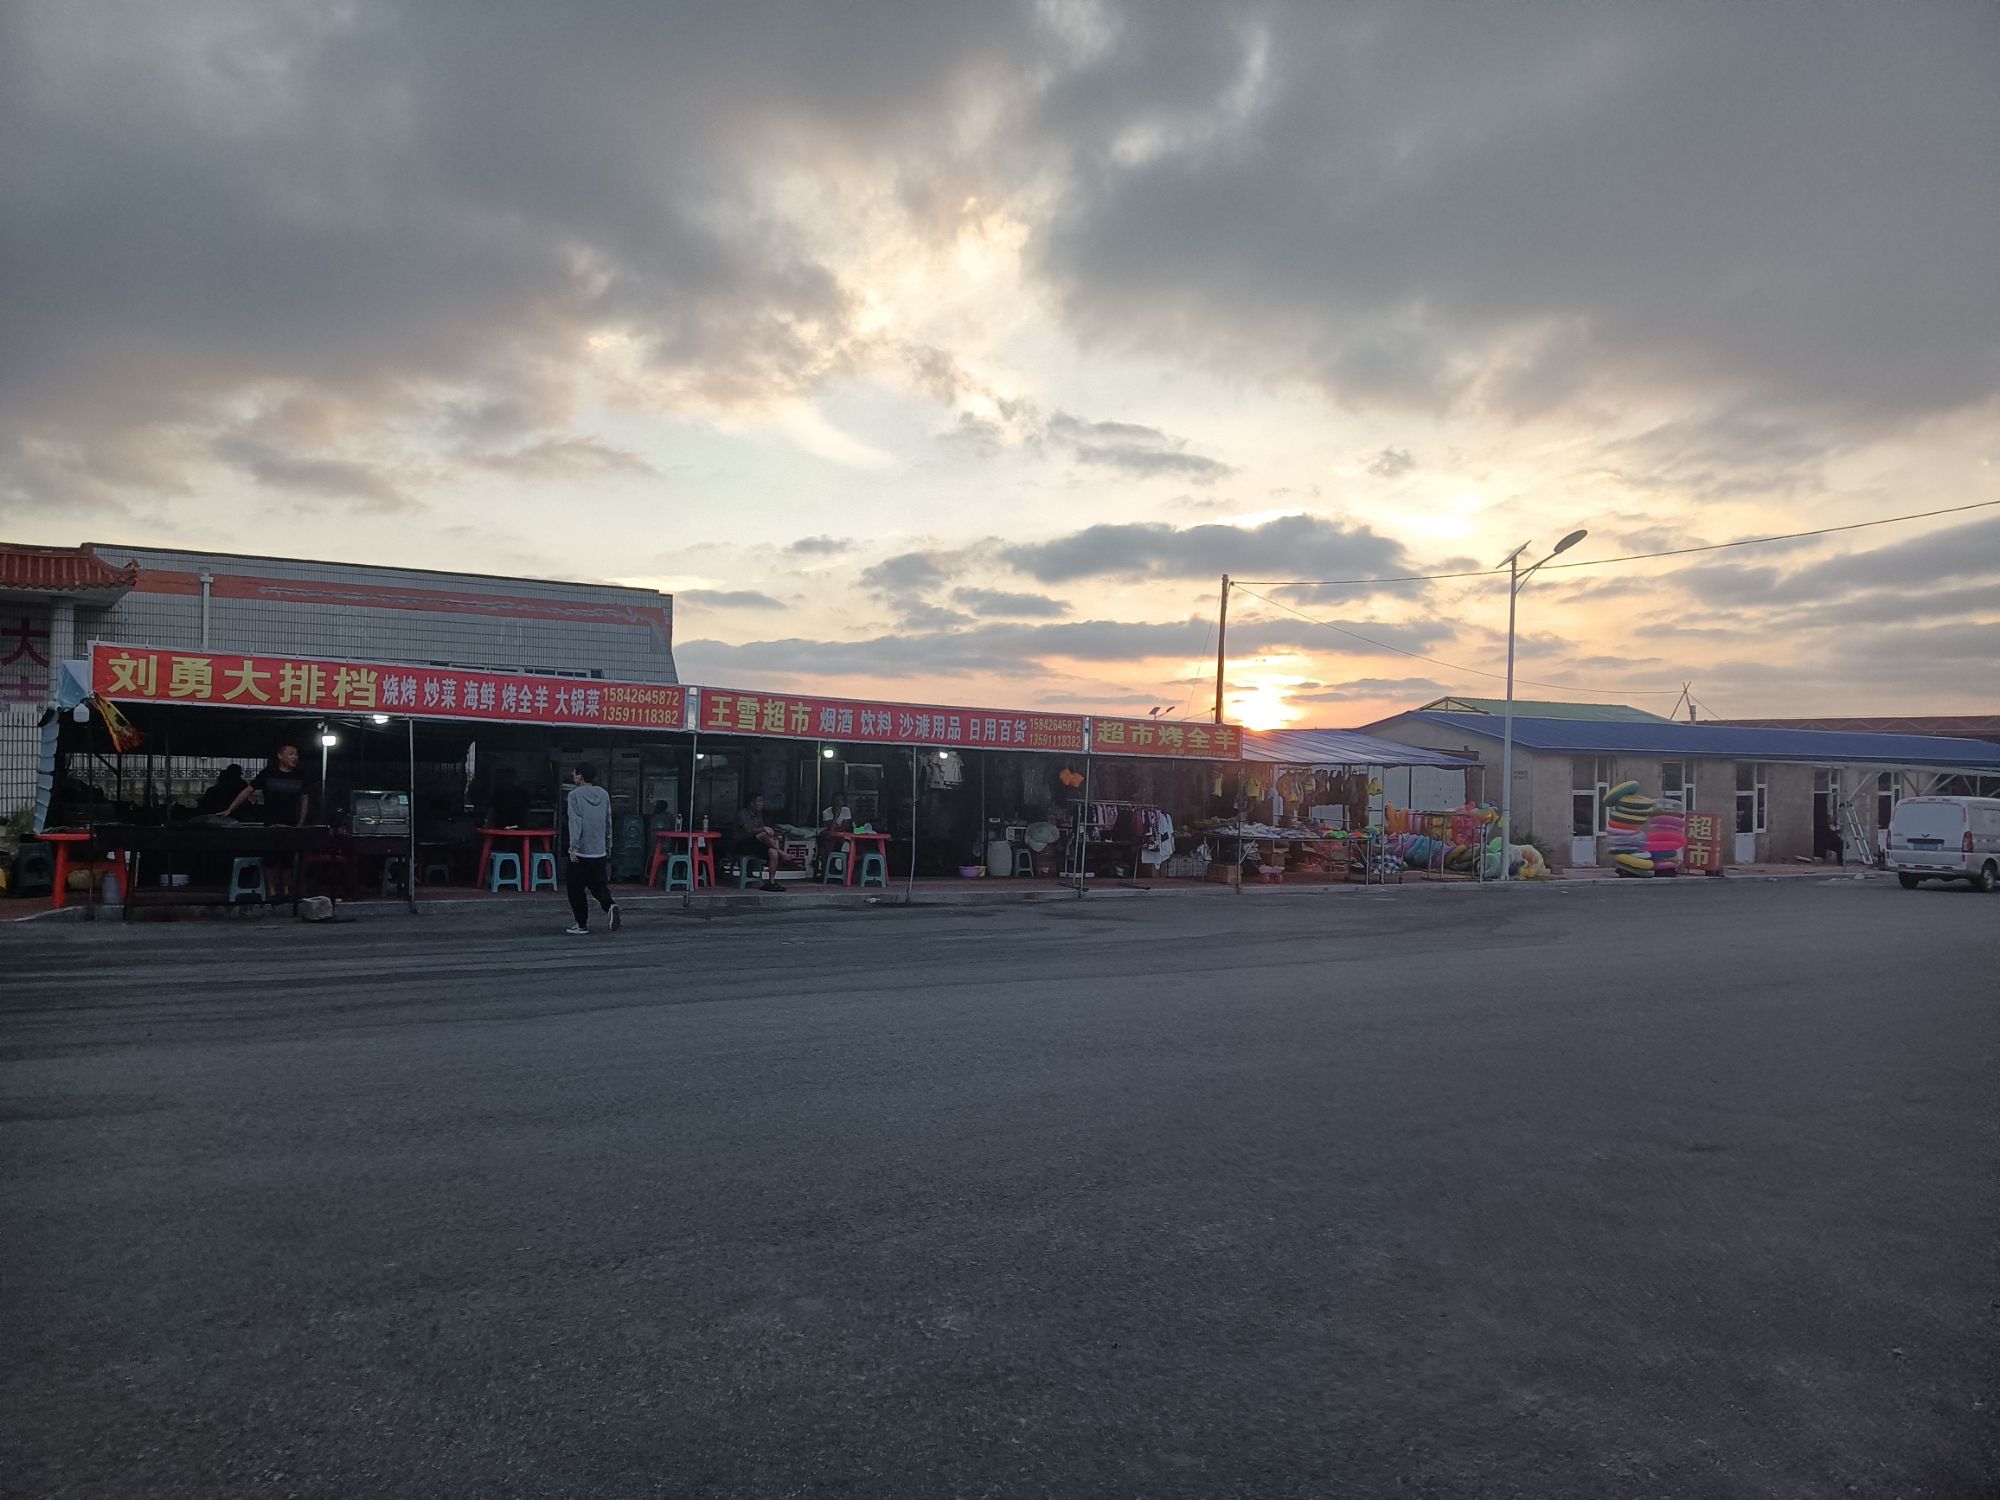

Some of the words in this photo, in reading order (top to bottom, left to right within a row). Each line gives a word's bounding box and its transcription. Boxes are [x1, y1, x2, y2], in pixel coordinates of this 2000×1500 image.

[107, 652, 379, 709] 刘勇大排档
[382, 674, 418, 707] 烧烤
[423, 676, 457, 709] 炒菜
[463, 680, 496, 711] 海鲜
[502, 682, 549, 716] 烤全羊
[554, 686, 600, 718] 大锅菜
[602, 687, 680, 706] 15842645872
[602, 706, 679, 725] 13591118382
[707, 695, 813, 734] 王雪超市
[819, 707, 853, 735] 烟酒
[860, 709, 892, 737] 饮料
[899, 713, 961, 741] 沙滩用品
[970, 718, 1028, 744] 日用百货
[1029, 718, 1081, 733] 15842645872
[1029, 733, 1081, 748] 13591118382
[1097, 720, 1238, 751] 超市烤全羊
[1687, 815, 1713, 867] 超市
